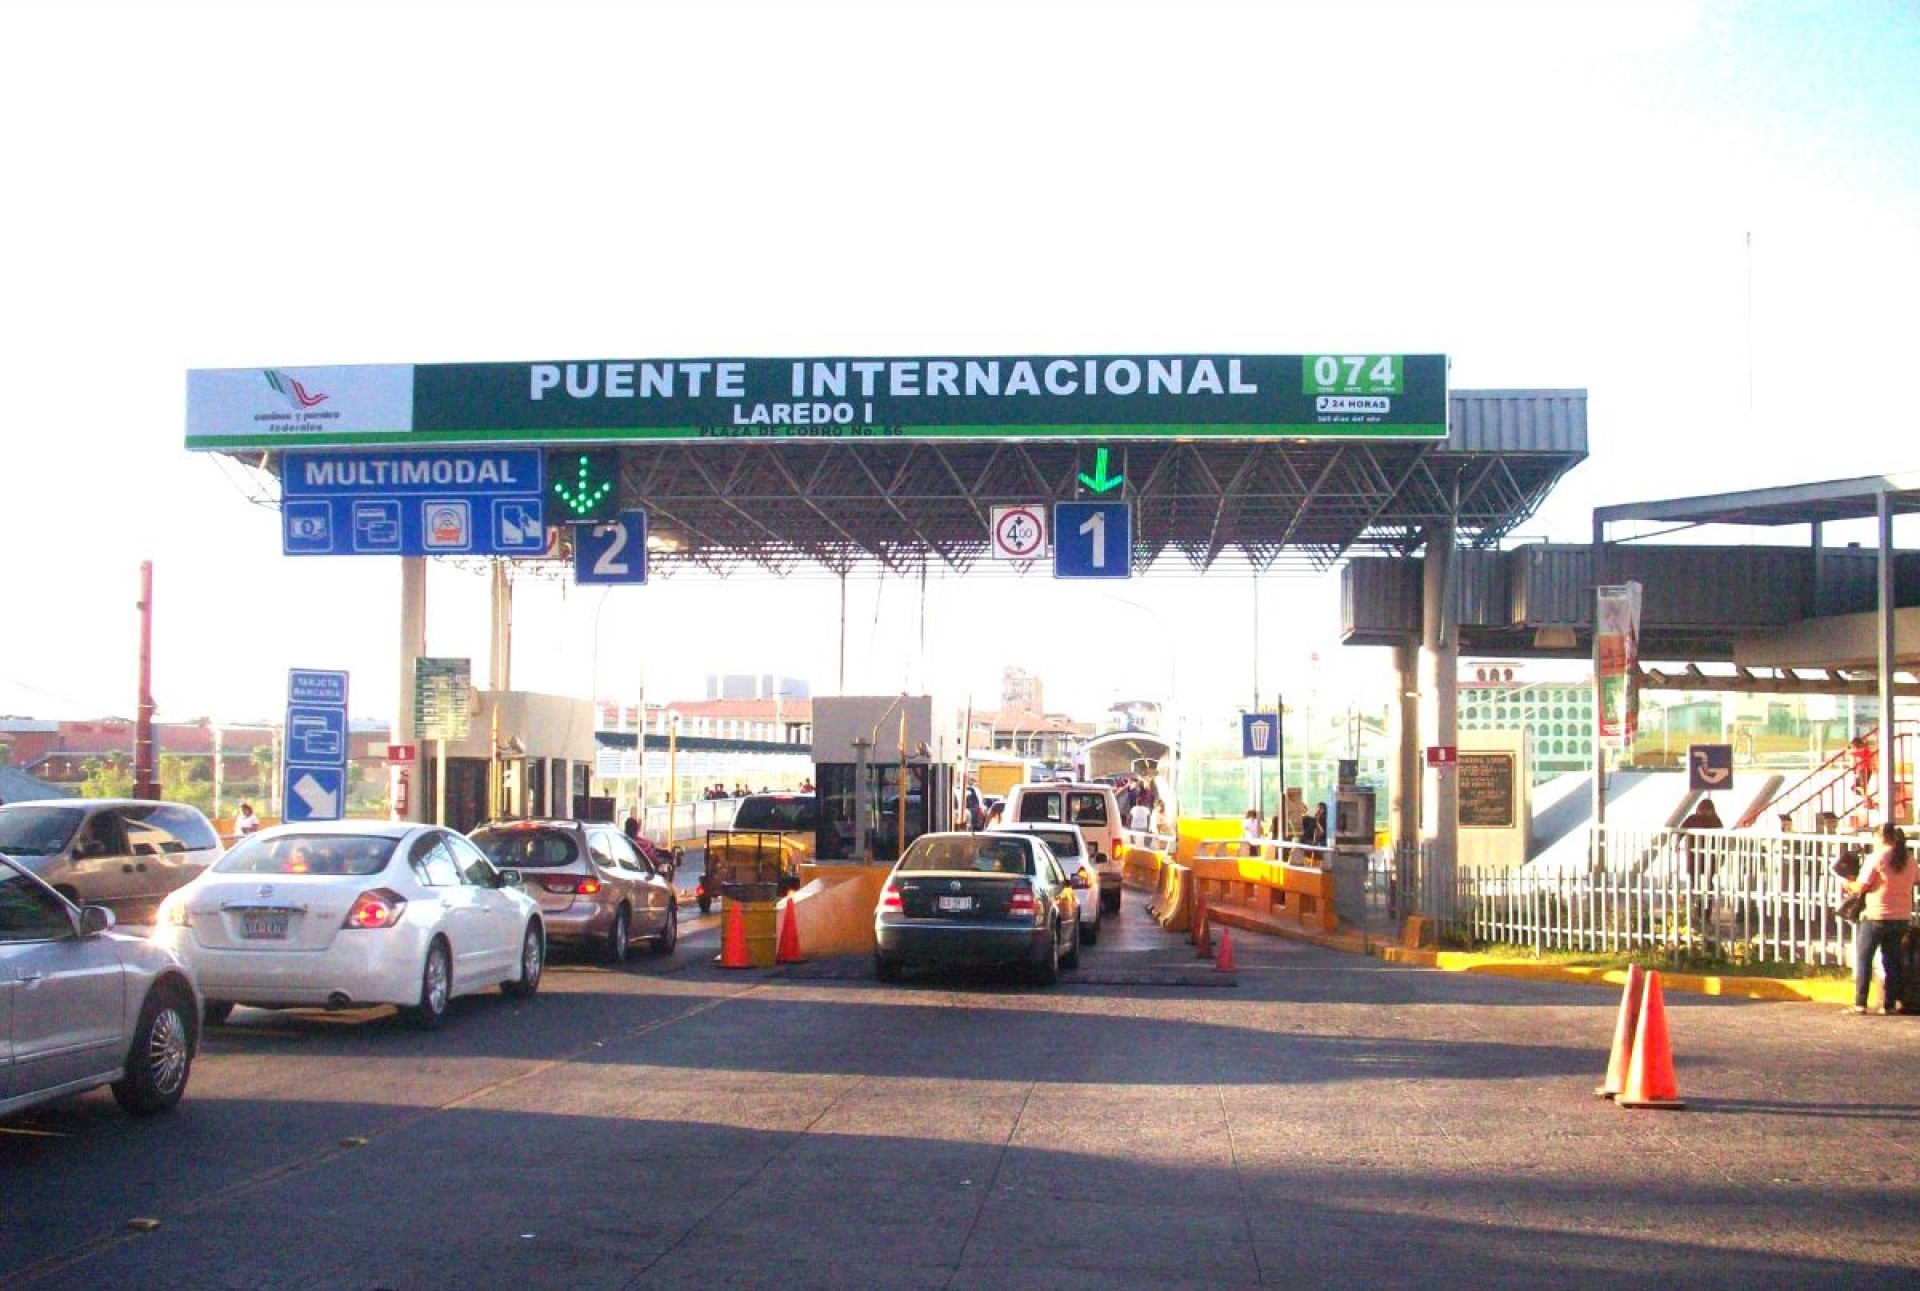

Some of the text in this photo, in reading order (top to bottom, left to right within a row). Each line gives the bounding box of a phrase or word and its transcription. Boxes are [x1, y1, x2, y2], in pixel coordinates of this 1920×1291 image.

[530, 359, 1258, 400] PUENTE INTERNACIONAL
[1314, 355, 1396, 387] 074
[733, 403, 874, 425] LAREDO I
[1332, 400, 1387, 408] 24 HORAS
[701, 426, 750, 436] PLAZA
[758, 426, 779, 436] DE
[786, 426, 843, 436] COBRO
[851, 425, 877, 436] No.
[305, 459, 517, 486] MULTIMODAL
[592, 521, 629, 575] 2
[1079, 511, 1105, 569] 1
